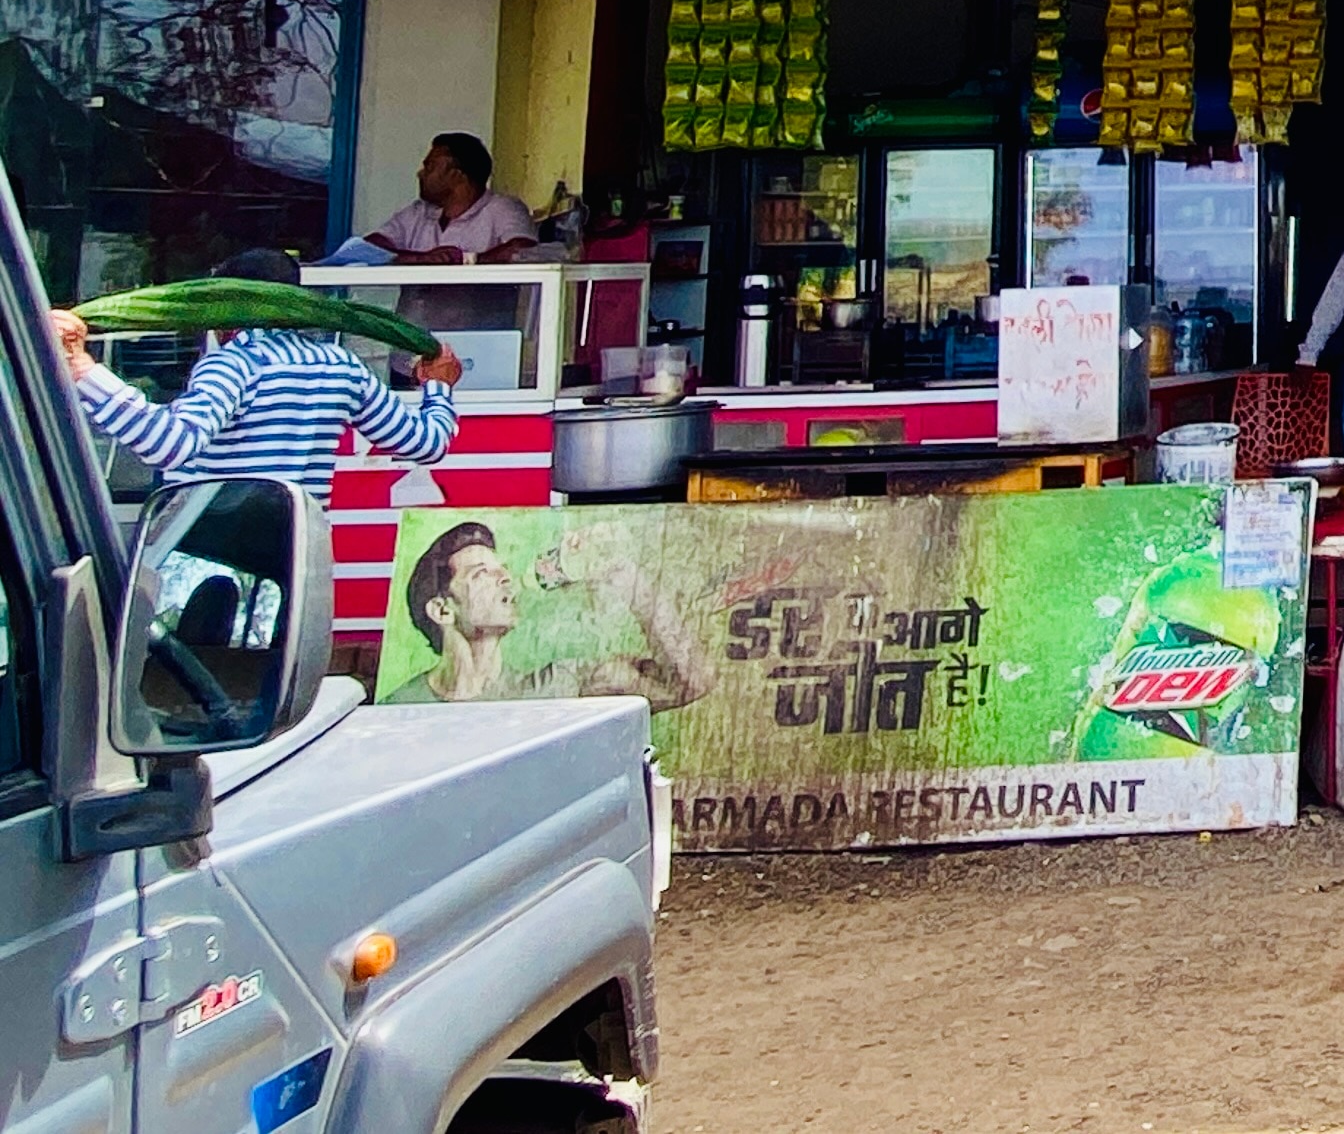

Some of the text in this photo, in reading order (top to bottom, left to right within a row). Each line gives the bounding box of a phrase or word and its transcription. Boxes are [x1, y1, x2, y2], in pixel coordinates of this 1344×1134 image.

[883, 596, 991, 651] आगे
[766, 640, 942, 736] जीत
[1118, 648, 1242, 676] Mountain
[672, 777, 1147, 834] ARMADA RESTAURANT
